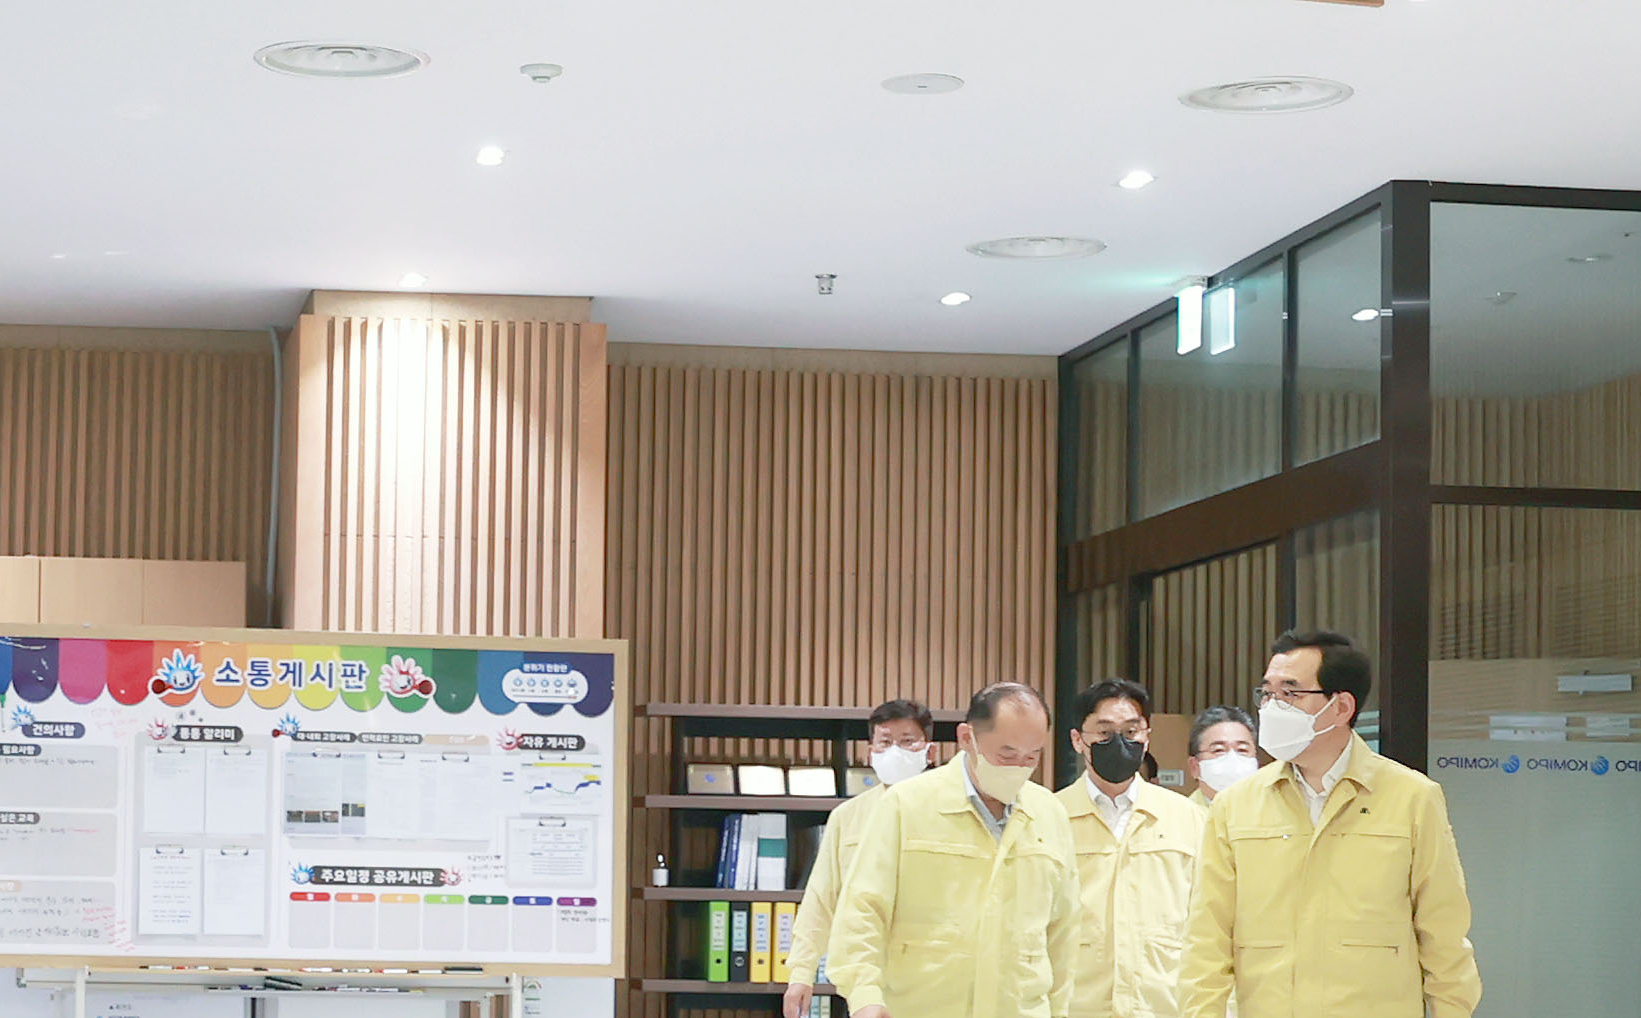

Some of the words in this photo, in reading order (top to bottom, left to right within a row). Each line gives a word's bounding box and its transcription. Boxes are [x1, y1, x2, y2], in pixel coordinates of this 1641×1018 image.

[215, 660, 367, 690] 소통게시판
[522, 735, 544, 749] 자유
[546, 736, 579, 749] 게시판
[320, 868, 371, 884] 주요일정
[372, 869, 435, 885] 공유게시판
